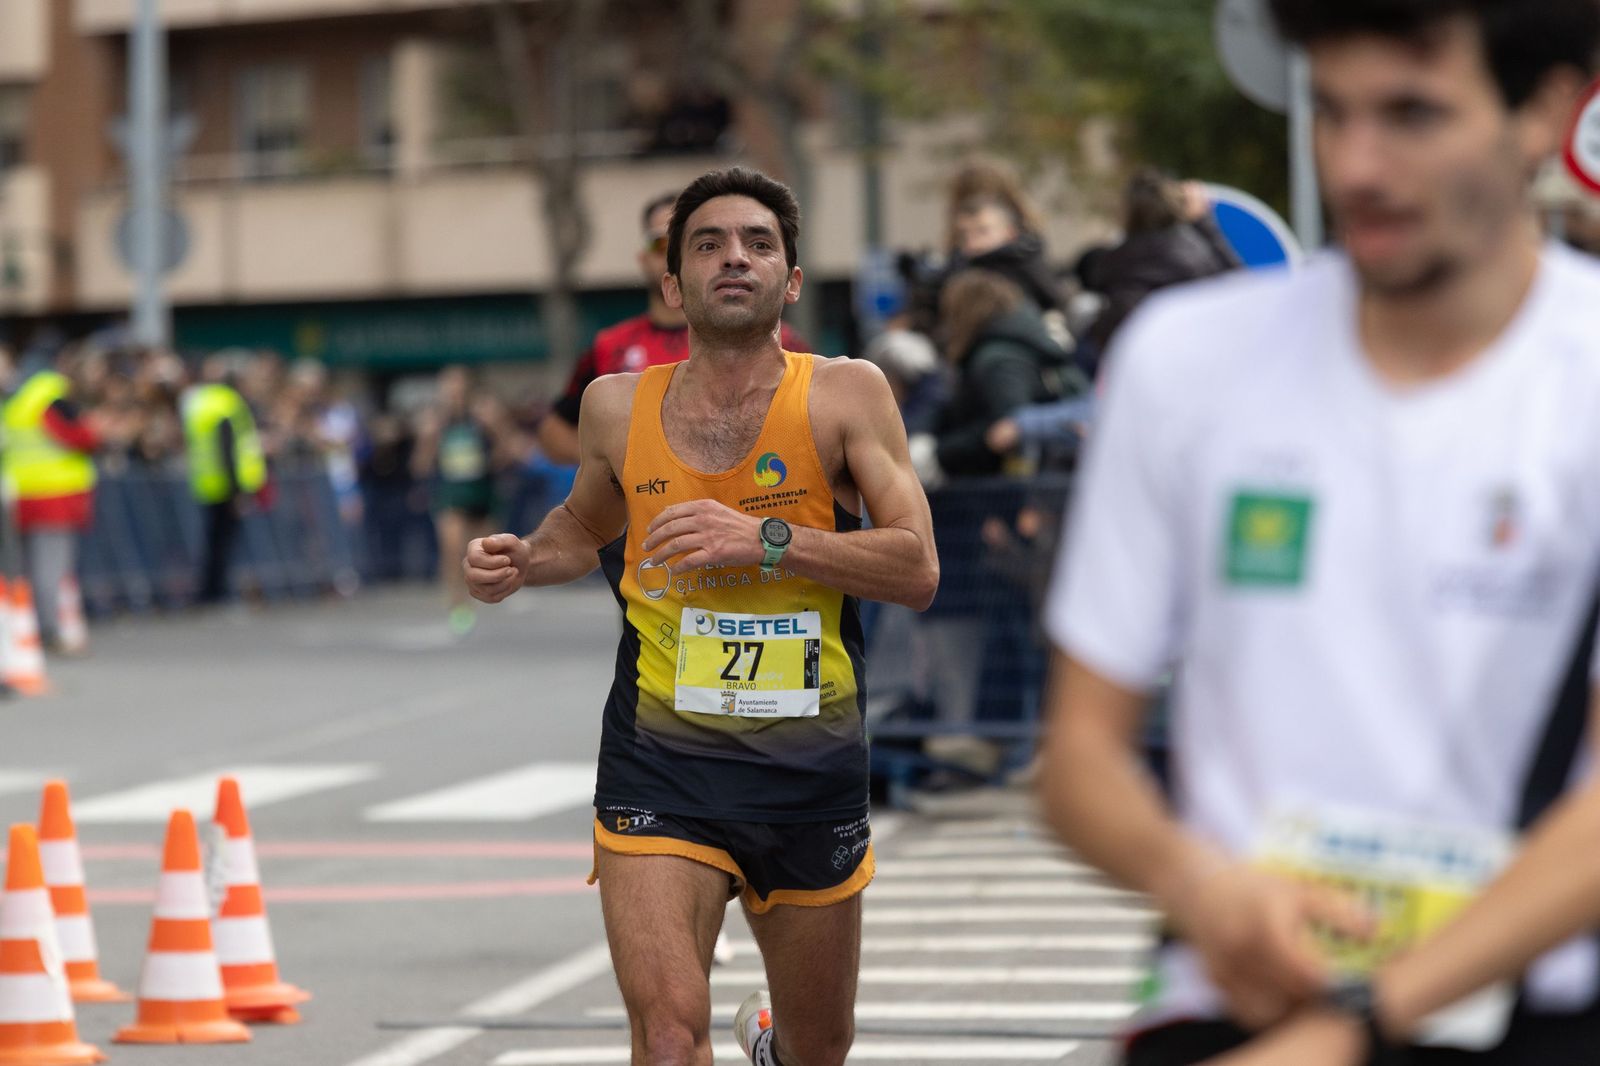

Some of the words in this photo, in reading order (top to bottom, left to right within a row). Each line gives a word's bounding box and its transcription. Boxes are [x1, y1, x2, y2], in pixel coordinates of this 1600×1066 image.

[636, 477, 670, 495] EKT
[739, 494, 770, 506] ESCUELA
[745, 499, 799, 511] SALMANTINA
[676, 572, 752, 593] CLÍNICA
[717, 618, 808, 636] SETEL
[720, 641, 765, 681] 27
[726, 681, 757, 690] BRAVO
